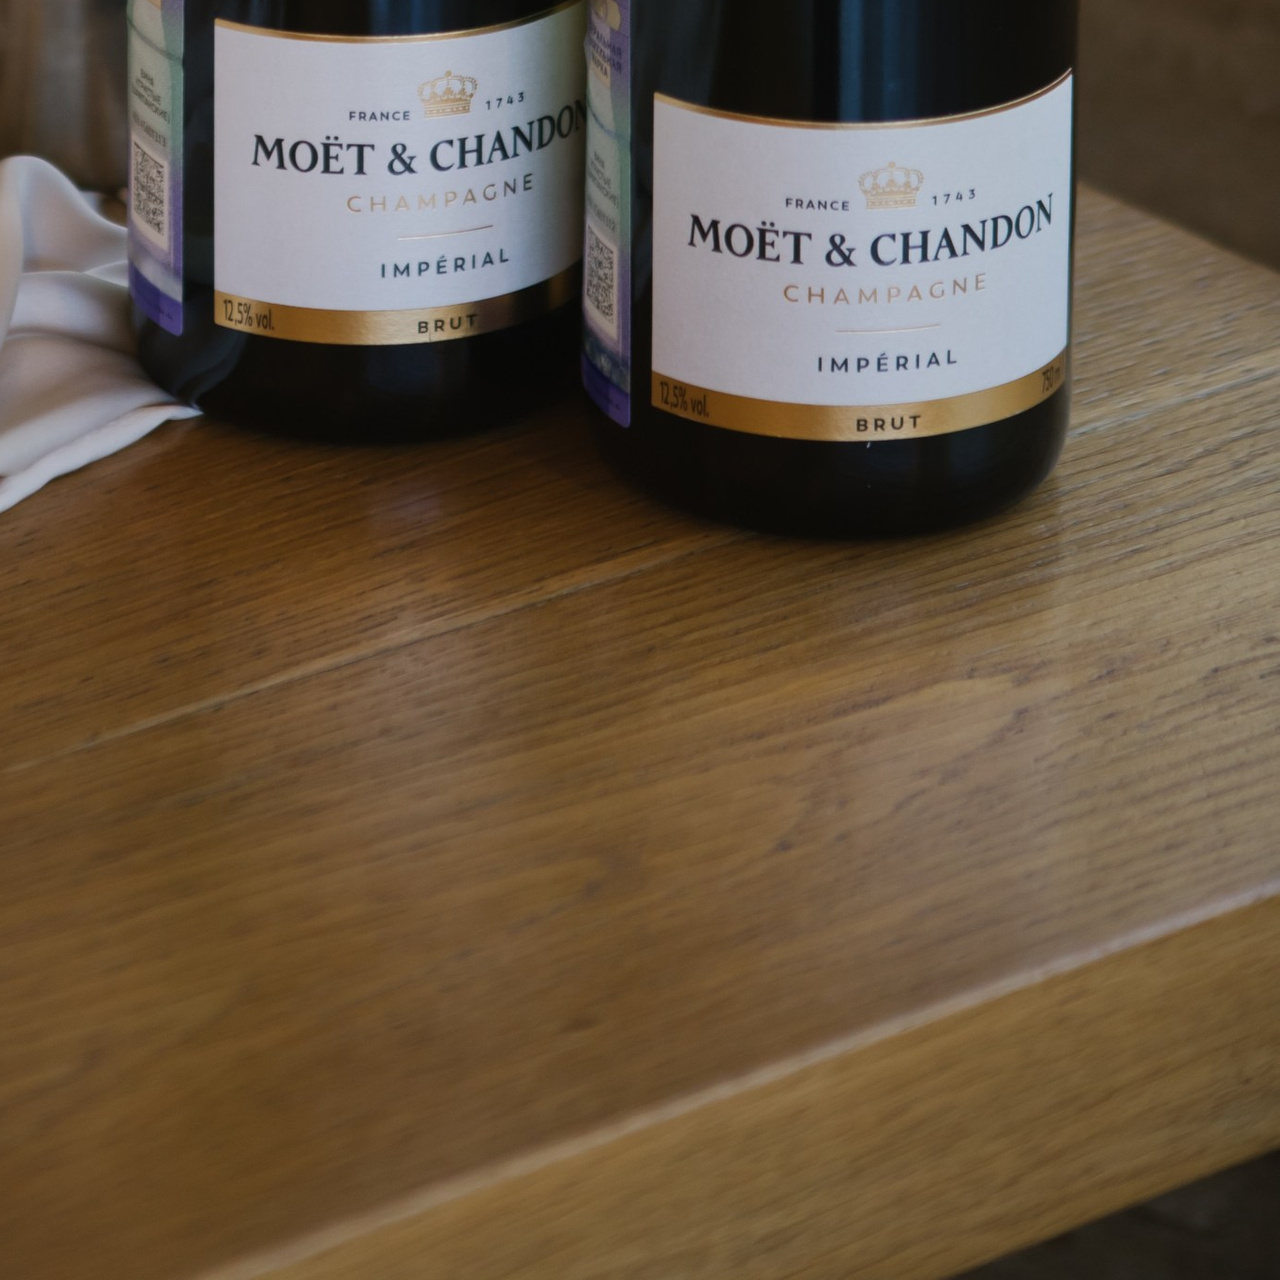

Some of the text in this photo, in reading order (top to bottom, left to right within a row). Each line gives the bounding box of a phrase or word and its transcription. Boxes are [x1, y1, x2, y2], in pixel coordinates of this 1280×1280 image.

[349, 92, 525, 121] FRANCE 1743
[252, 135, 375, 175] MOËT
[387, 143, 418, 175] &
[346, 173, 534, 213] CHAMPAGNE
[785, 189, 976, 211] FRANCE 1743
[687, 193, 1053, 267] MOËT & CHANDON
[381, 248, 510, 278] IMPÉRIAL
[783, 273, 987, 304] CHAMPAGNE
[223, 299, 275, 330] 12,5% vol.
[417, 313, 478, 334] BRUT
[817, 349, 958, 373] IMPÉRIAL
[856, 415, 922, 433] BRUT
